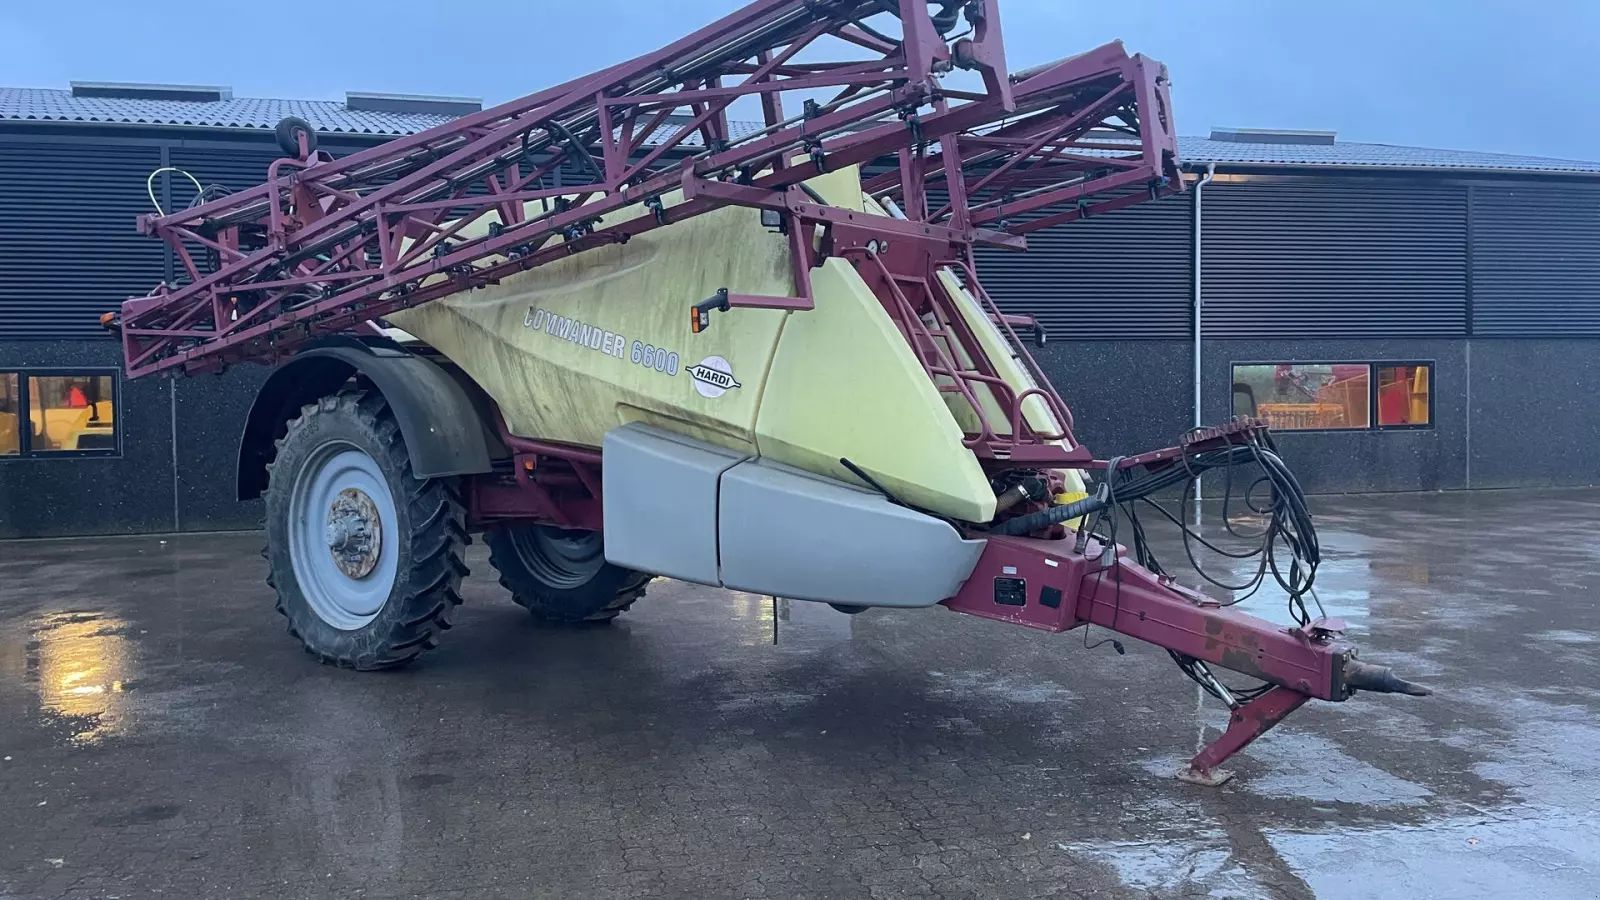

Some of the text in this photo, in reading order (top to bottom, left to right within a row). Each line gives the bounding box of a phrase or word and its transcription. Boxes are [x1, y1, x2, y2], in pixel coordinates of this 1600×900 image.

[523, 306, 679, 376] COMMANDER 6600
[696, 368, 731, 387] HARDI
